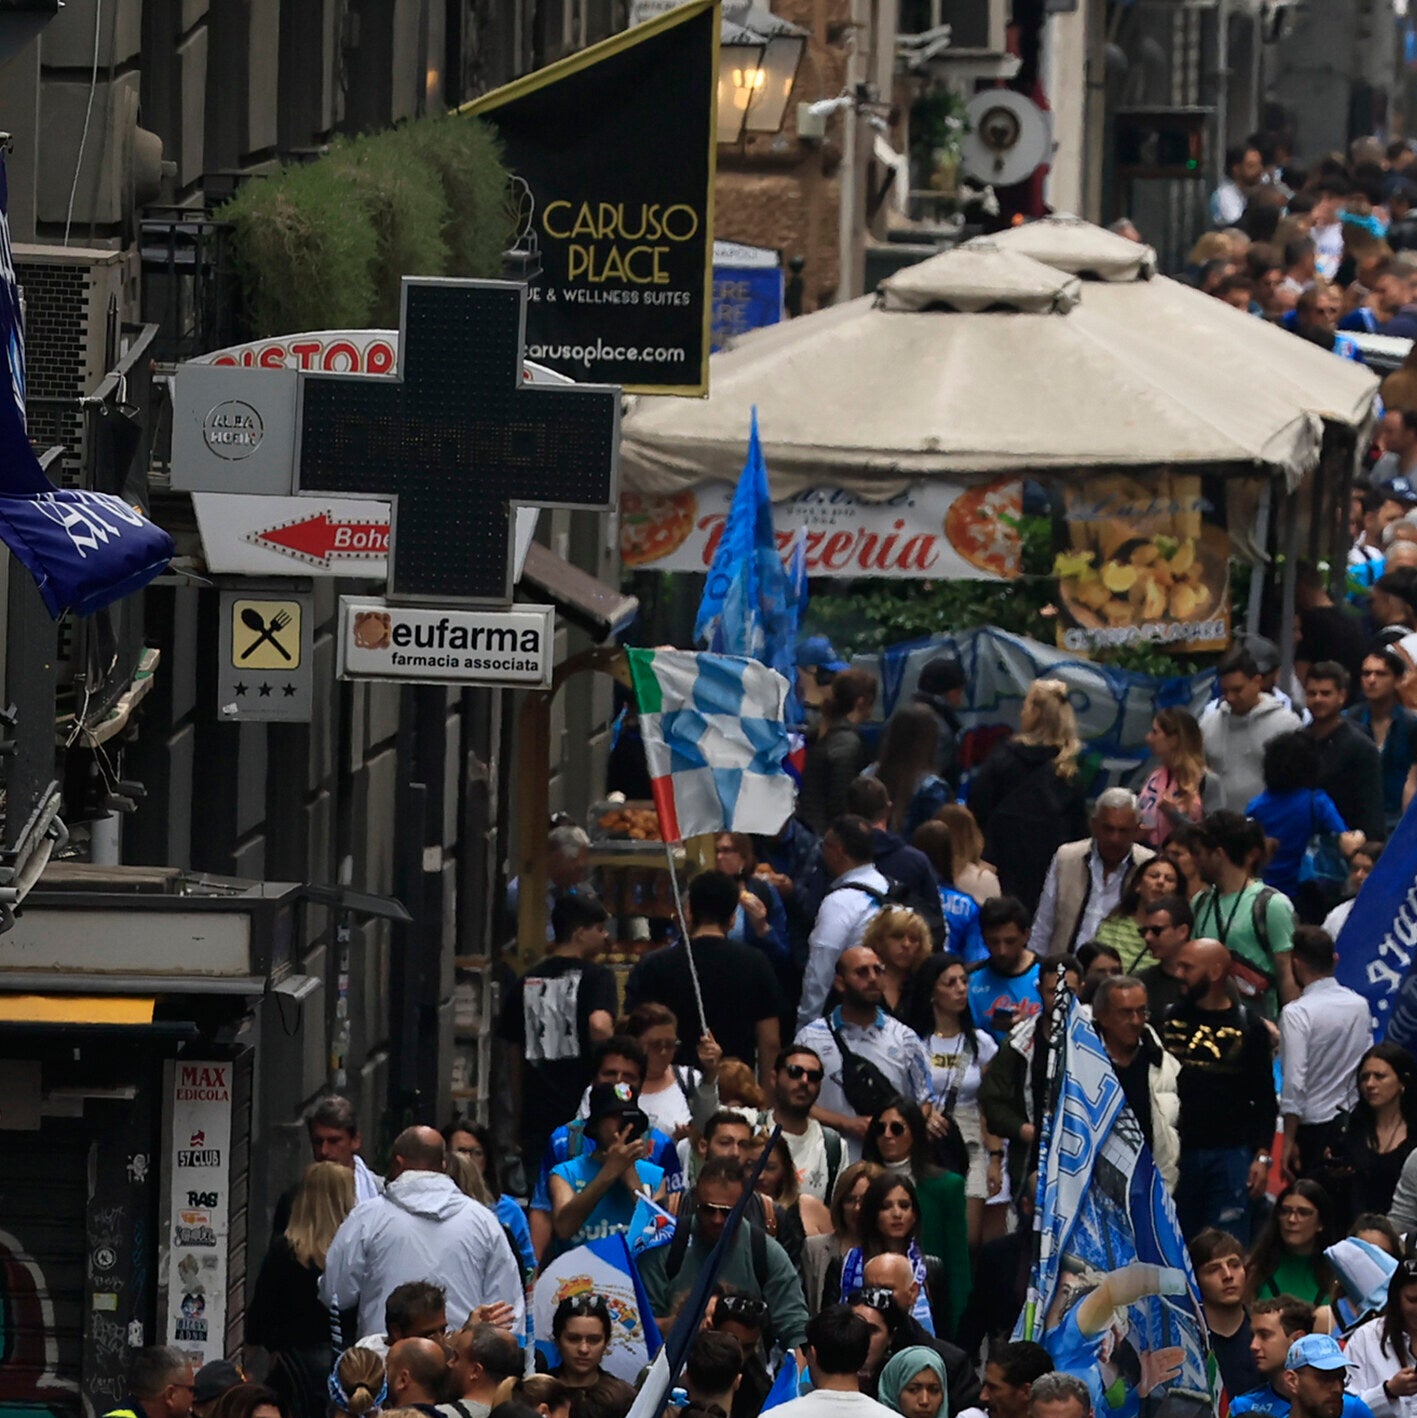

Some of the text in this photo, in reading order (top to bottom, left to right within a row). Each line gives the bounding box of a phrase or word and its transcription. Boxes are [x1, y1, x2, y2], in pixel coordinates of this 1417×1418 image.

[543, 200, 699, 242] CARUSO
[568, 245, 670, 284] PLACE
[546, 288, 556, 302] &
[563, 289, 639, 306] WELLNESS
[642, 291, 691, 307] SUITES
[391, 617, 541, 654] eufarma
[391, 652, 540, 672] farmacia associata
[181, 1065, 228, 1088] MAX
[176, 1088, 230, 1102] EDICOLA
